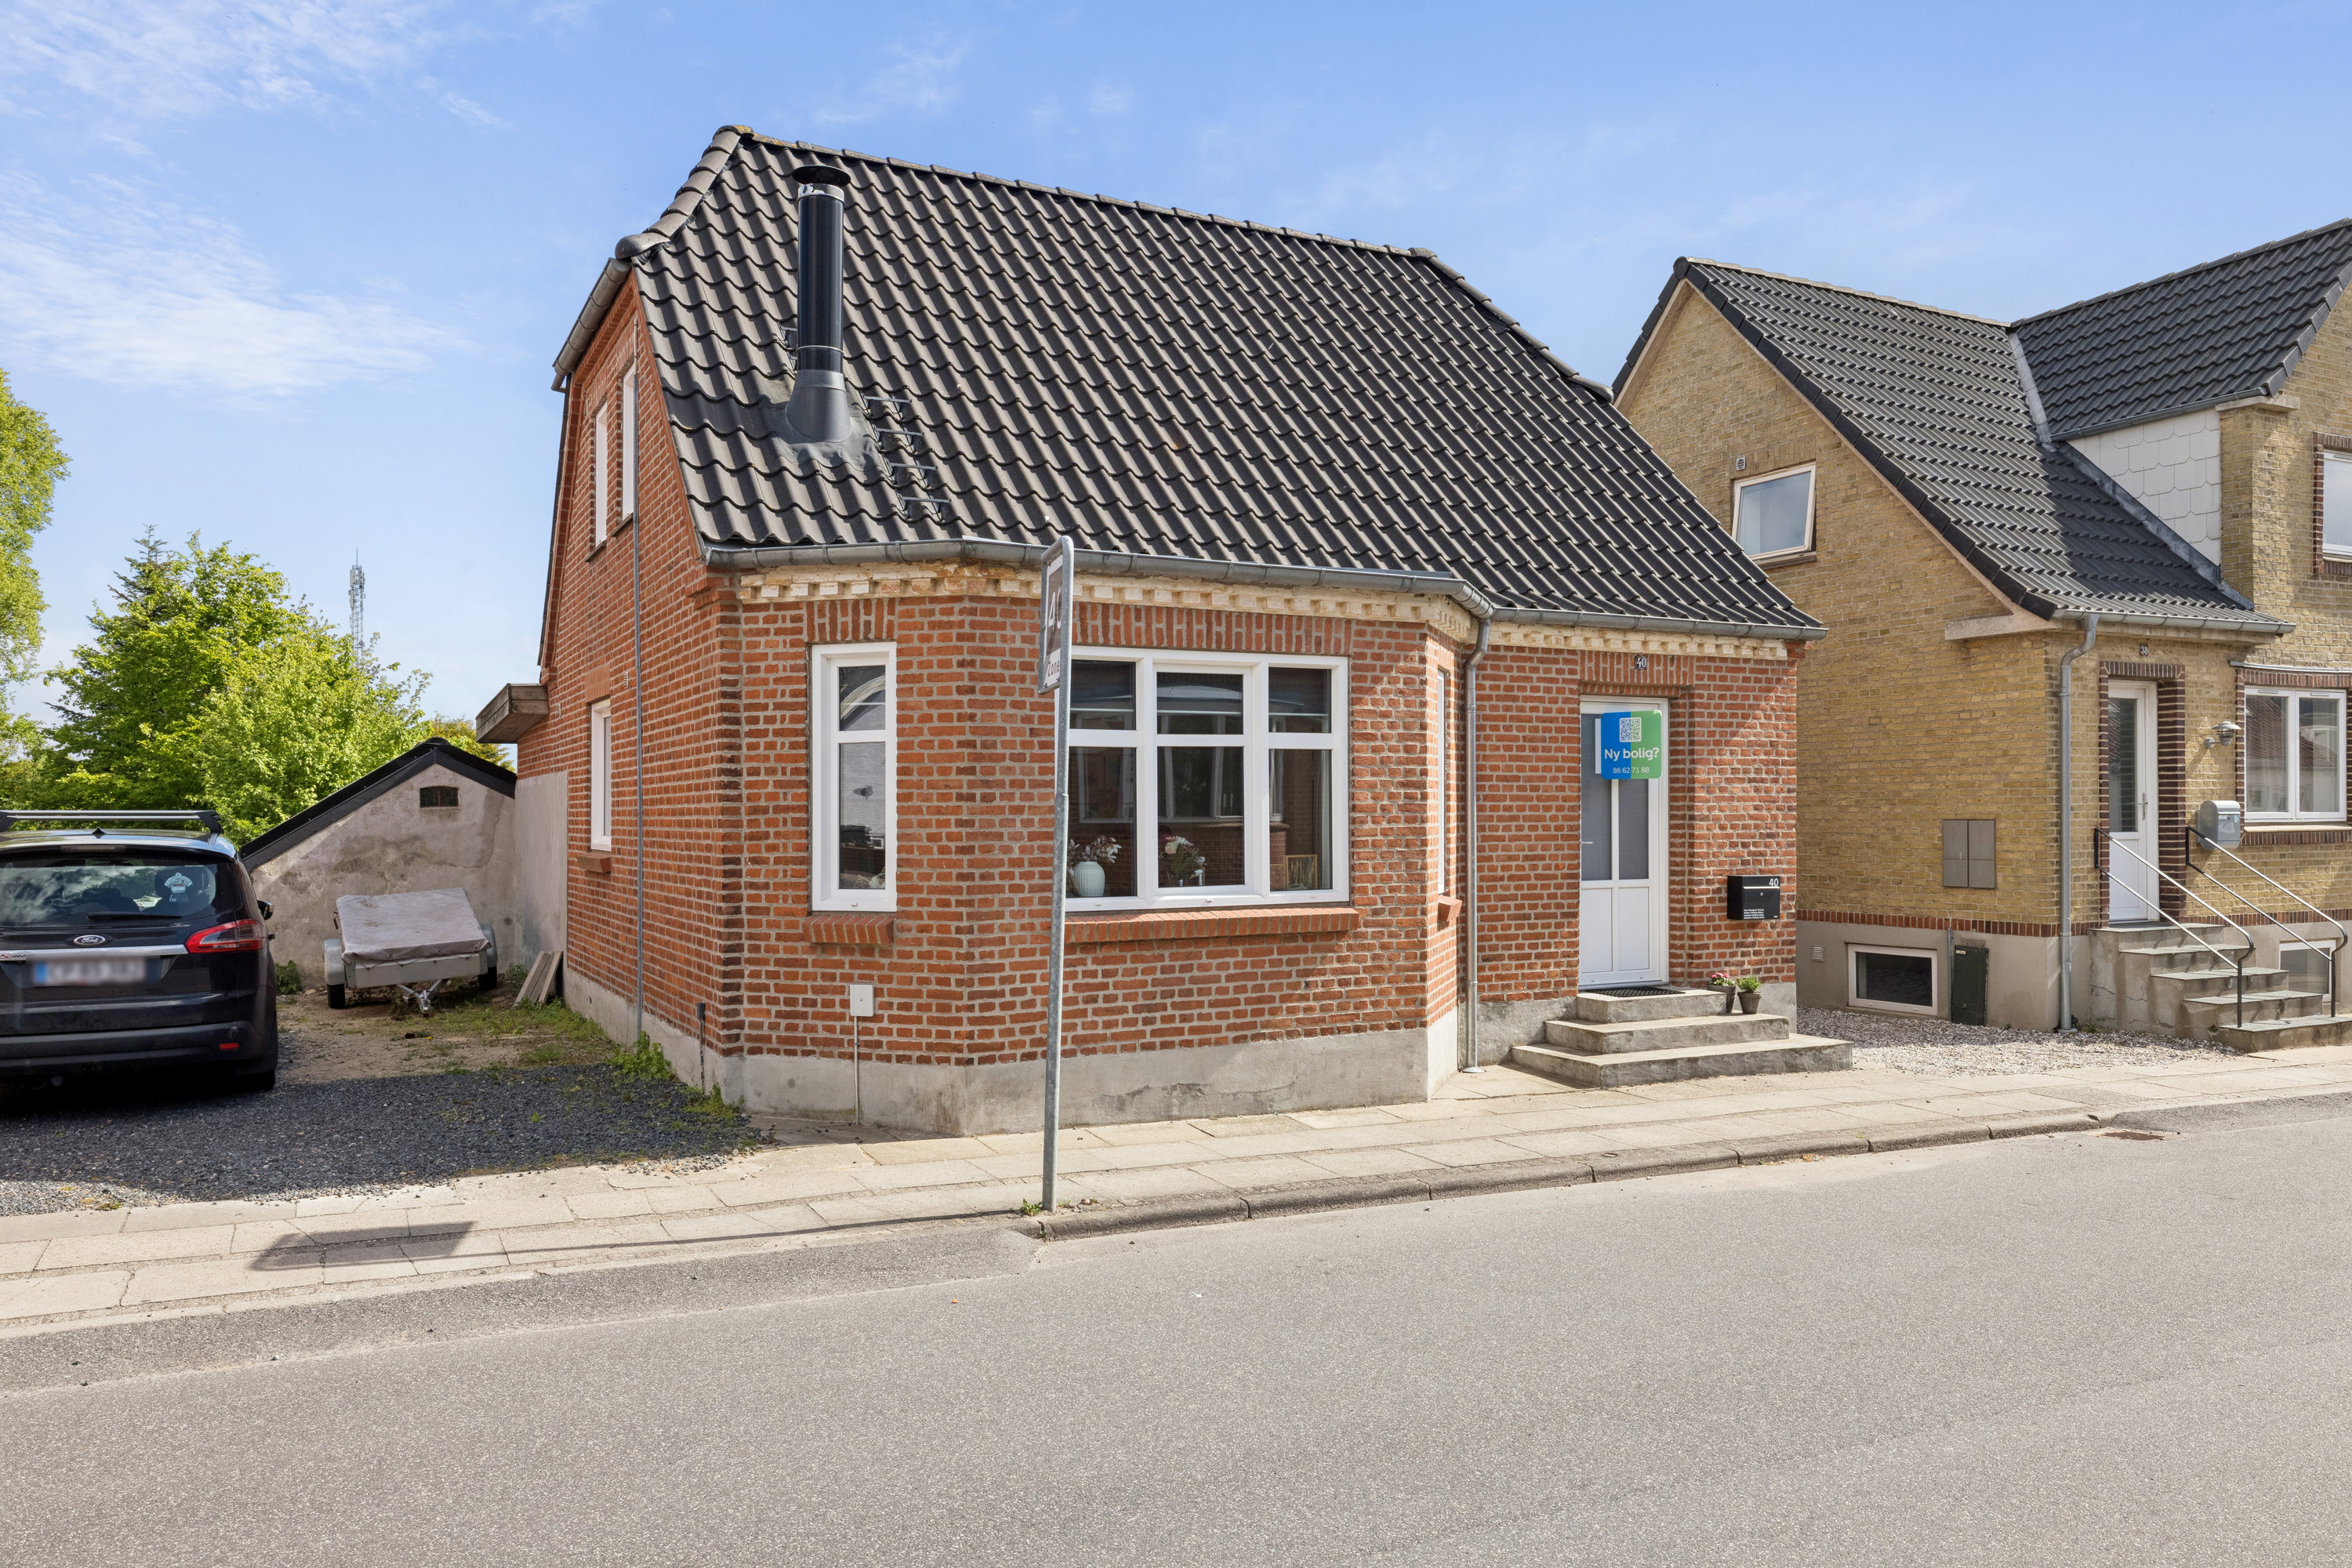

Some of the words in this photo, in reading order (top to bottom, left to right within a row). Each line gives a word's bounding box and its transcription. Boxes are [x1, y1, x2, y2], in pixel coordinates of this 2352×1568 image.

[1047, 586, 1062, 633] 40
[2141, 645, 2148, 655] 38
[1047, 659, 1061, 677] Zone
[1636, 657, 1646, 668] 40
[1604, 748, 1621, 761] Ny
[1623, 747, 1660, 760] bolig?
[1769, 877, 1779, 887] 40
